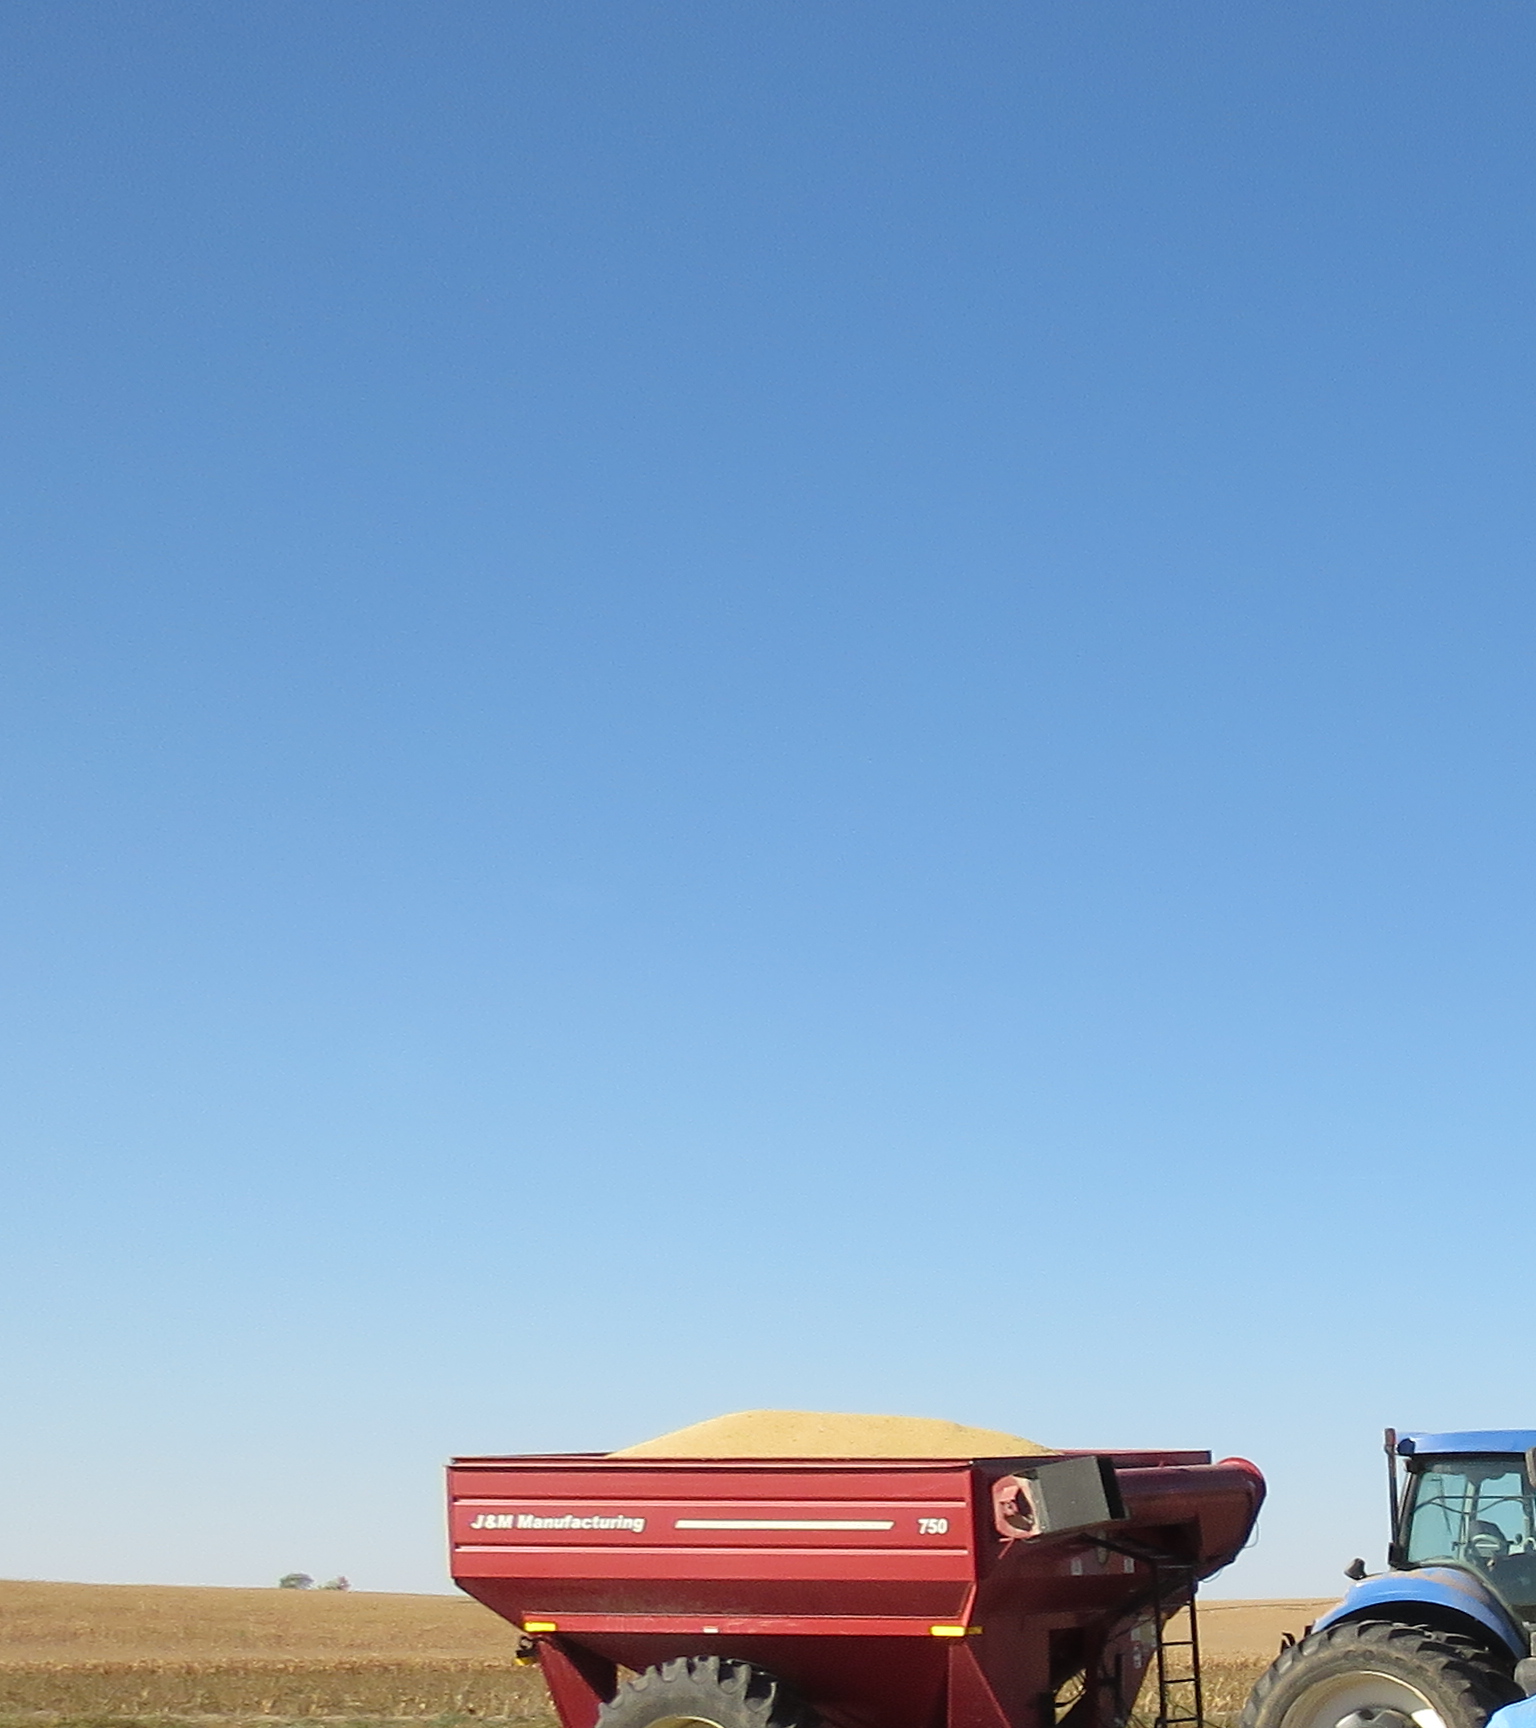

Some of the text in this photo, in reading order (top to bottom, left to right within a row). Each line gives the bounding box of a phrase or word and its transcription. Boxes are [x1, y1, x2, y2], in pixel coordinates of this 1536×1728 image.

[470, 1513, 647, 1533] J&M Manufacturing
[917, 1518, 949, 1535] 750
